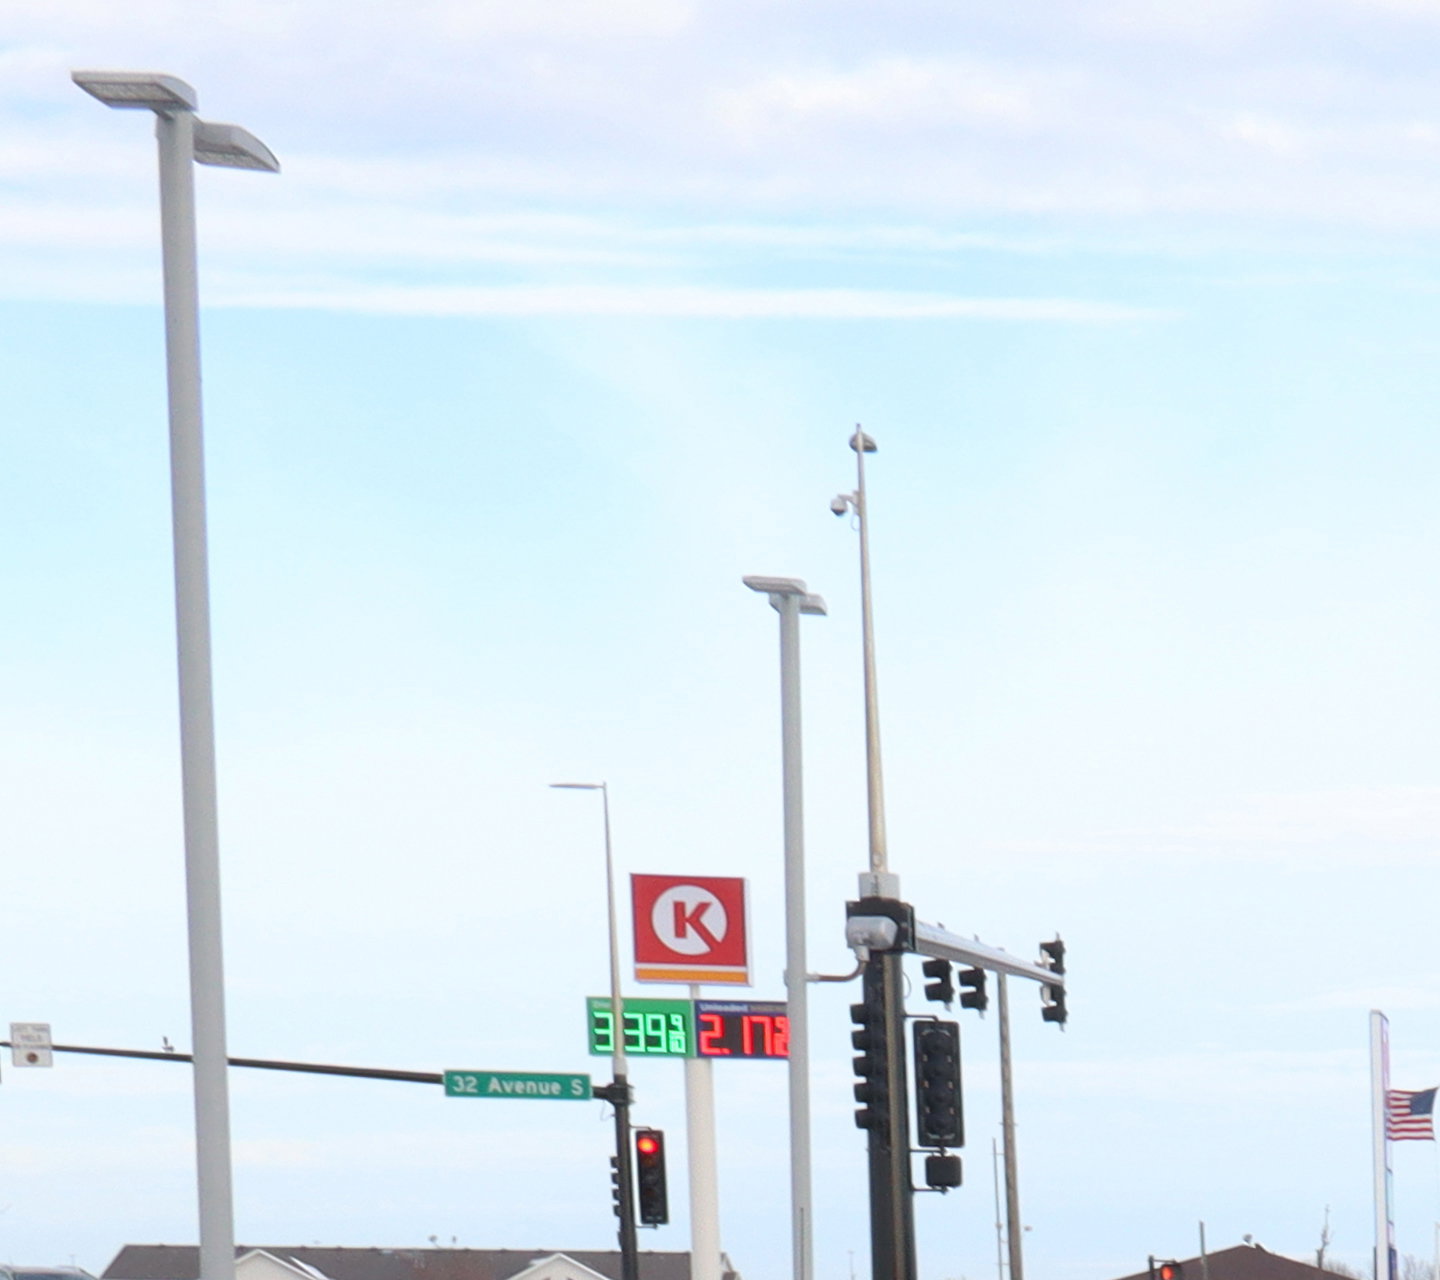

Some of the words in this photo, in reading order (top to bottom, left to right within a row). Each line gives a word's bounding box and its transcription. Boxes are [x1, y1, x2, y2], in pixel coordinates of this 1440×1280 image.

[670, 898, 722, 954] K
[452, 1075, 478, 1093] 32
[488, 1077, 561, 1095] Avenue
[571, 1079, 583, 1096] S
